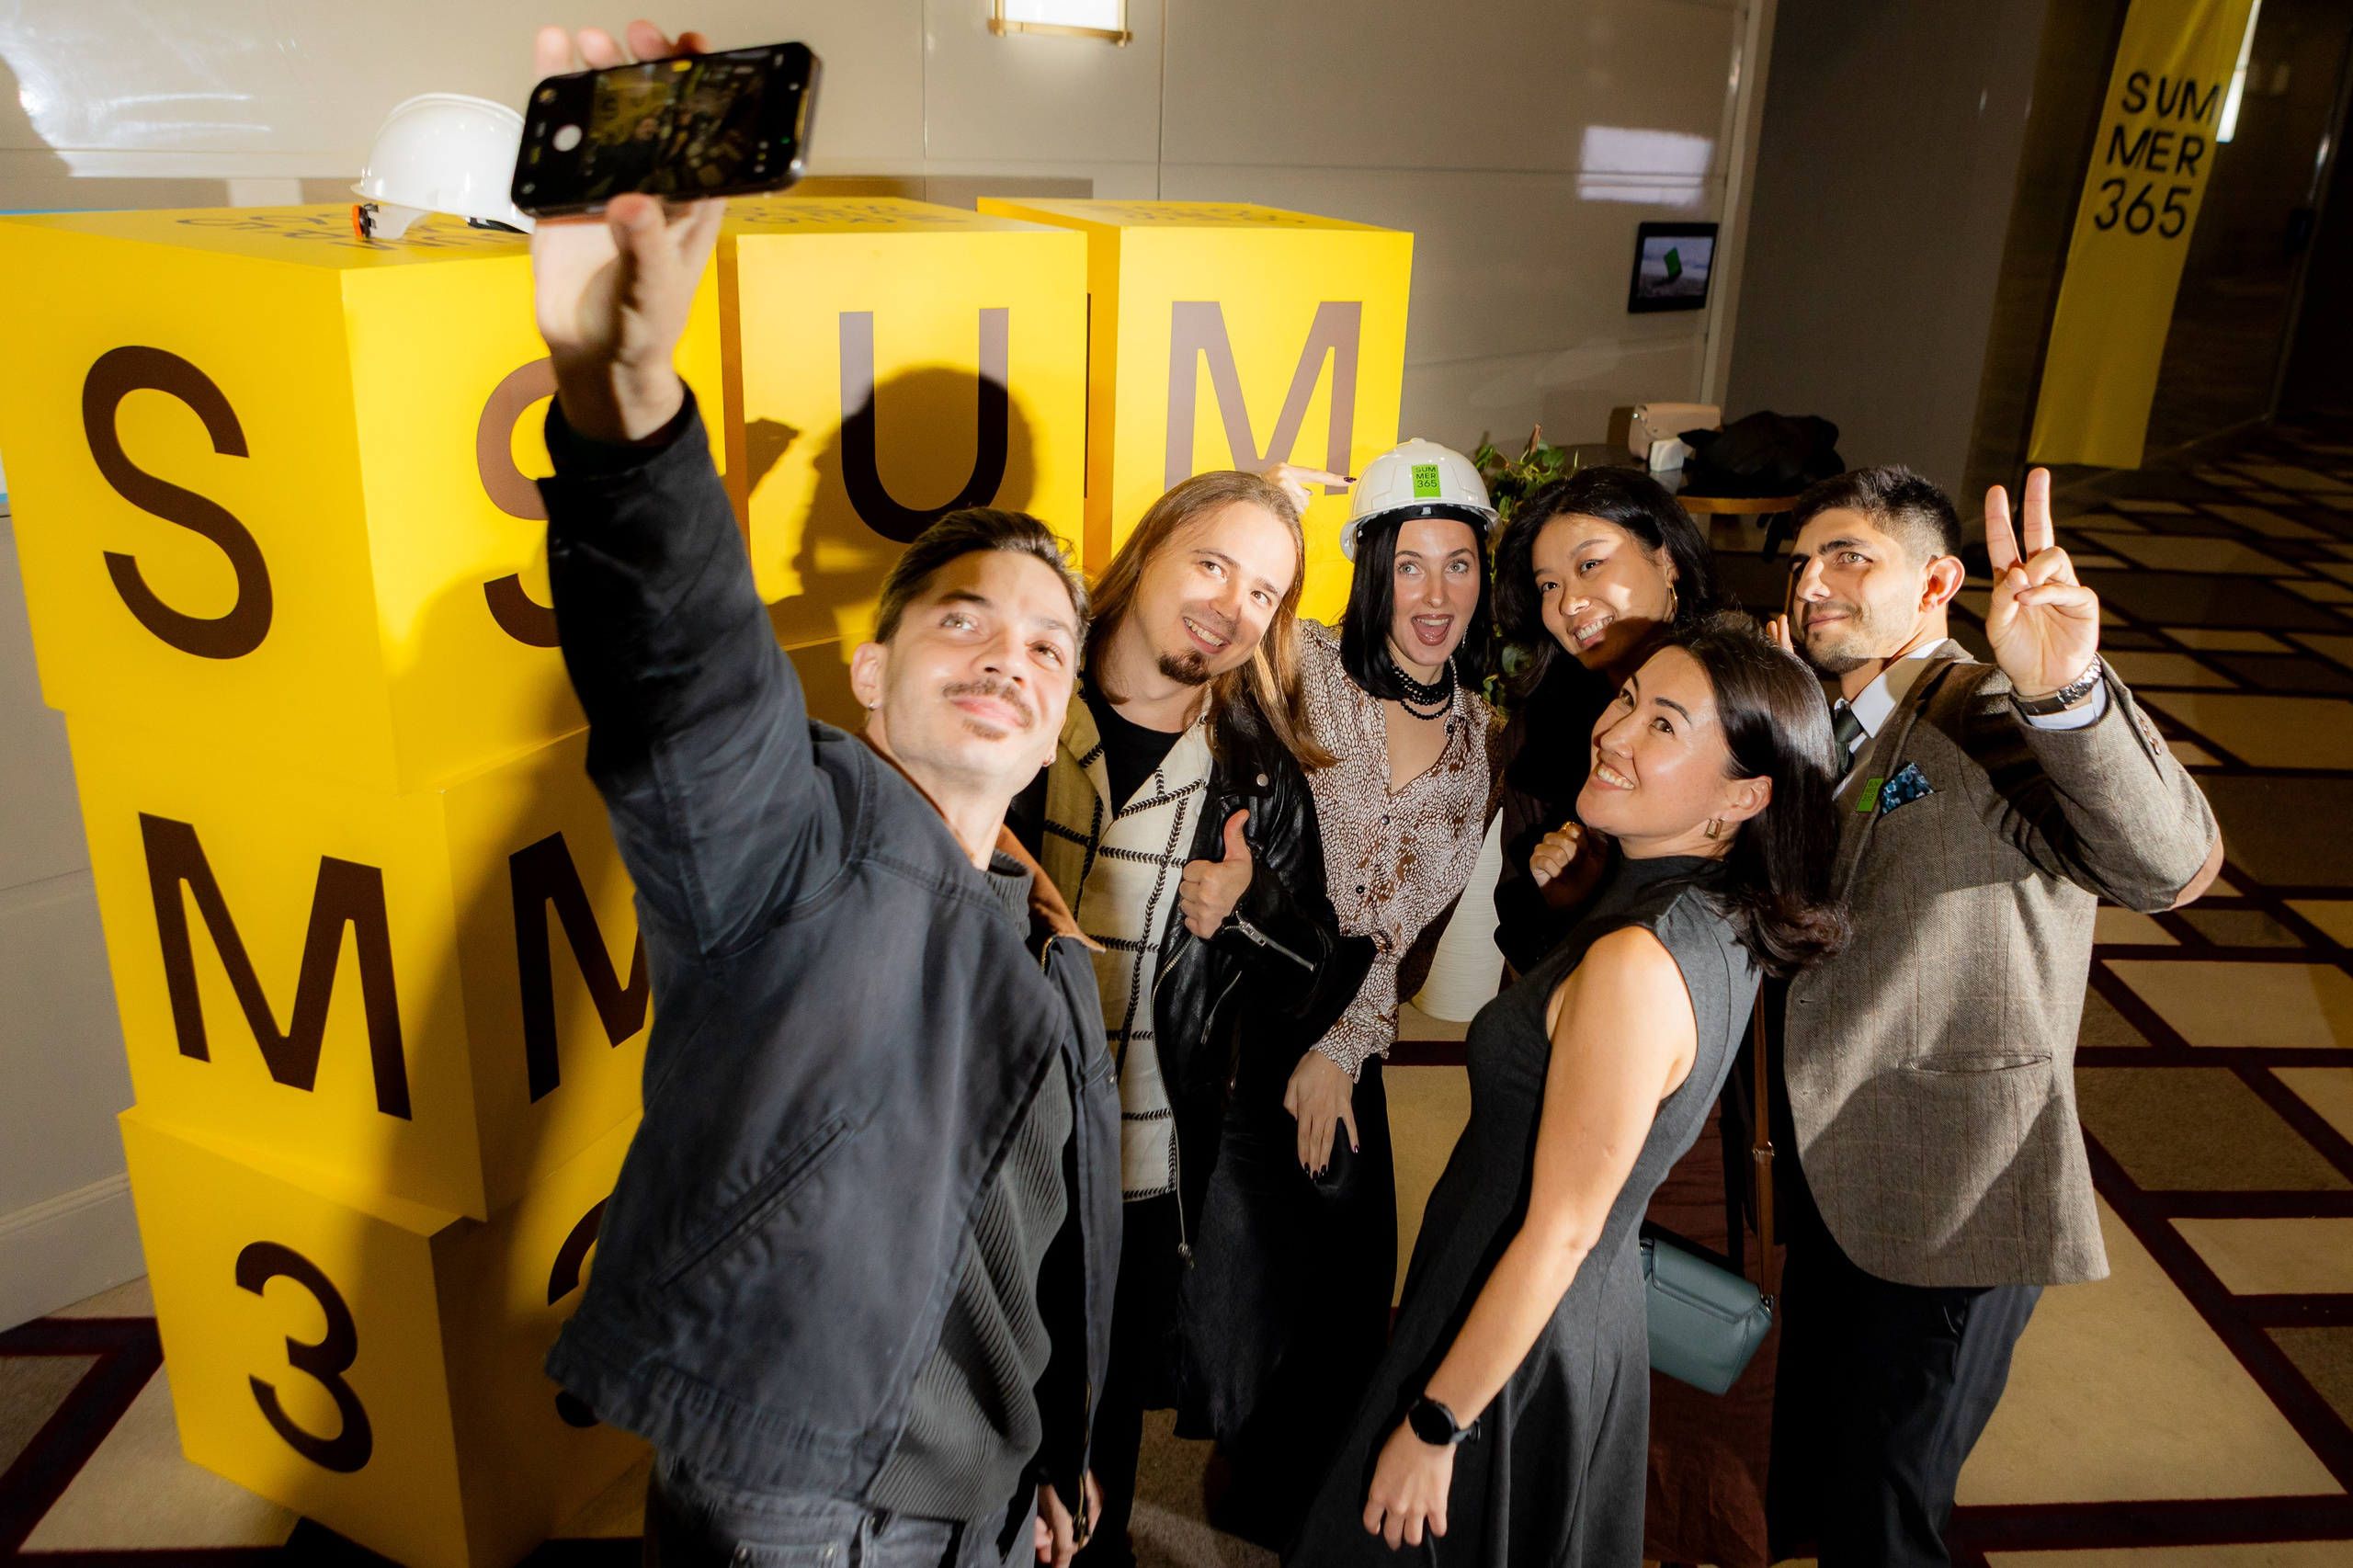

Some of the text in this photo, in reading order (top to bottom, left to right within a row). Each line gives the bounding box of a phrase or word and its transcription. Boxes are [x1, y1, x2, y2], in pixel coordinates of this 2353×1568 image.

[2107, 125, 2205, 177] MER
[2122, 71, 2221, 125] SUM
[2095, 178, 2192, 239] 365
[839, 307, 1009, 544] U
[1165, 301, 1362, 497] M
[1416, 479, 1438, 488] 365
[82, 346, 273, 659] S
[139, 812, 412, 1121] M
[235, 1241, 373, 1473] 3
